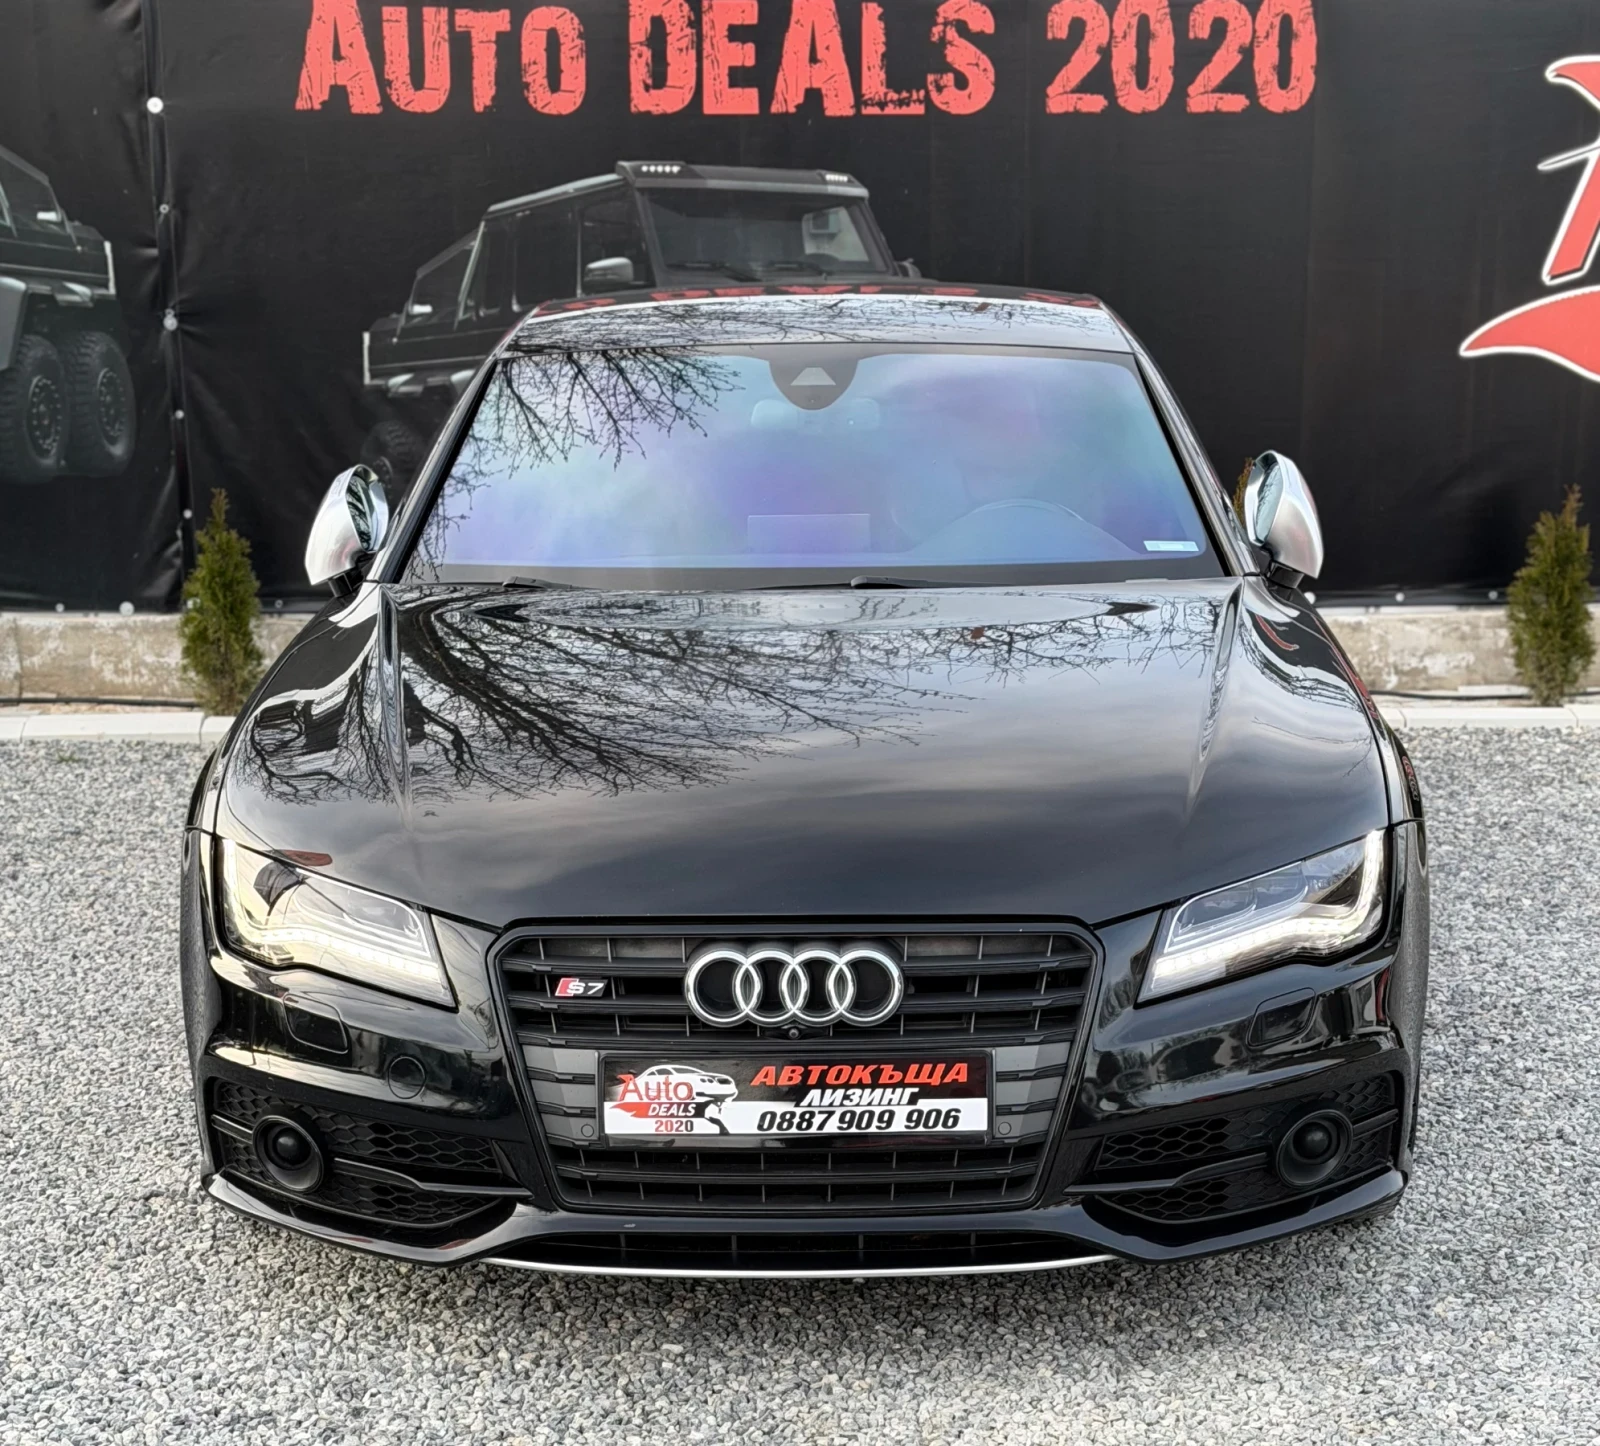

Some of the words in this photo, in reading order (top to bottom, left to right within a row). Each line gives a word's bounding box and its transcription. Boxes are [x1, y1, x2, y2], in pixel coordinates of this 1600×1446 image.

[295, 0, 587, 115] AUTO
[629, 0, 996, 116] DEALS
[1045, 0, 1318, 114] 2020
[566, 981, 605, 995] S7
[750, 1062, 969, 1087] АВТОКЪЩА
[616, 1073, 695, 1102] Auto
[799, 1087, 920, 1108] ЛИЗИНГ
[647, 1103, 698, 1117] DEALS
[903, 1108, 962, 1131] 906
[654, 1119, 695, 1133] 2020
